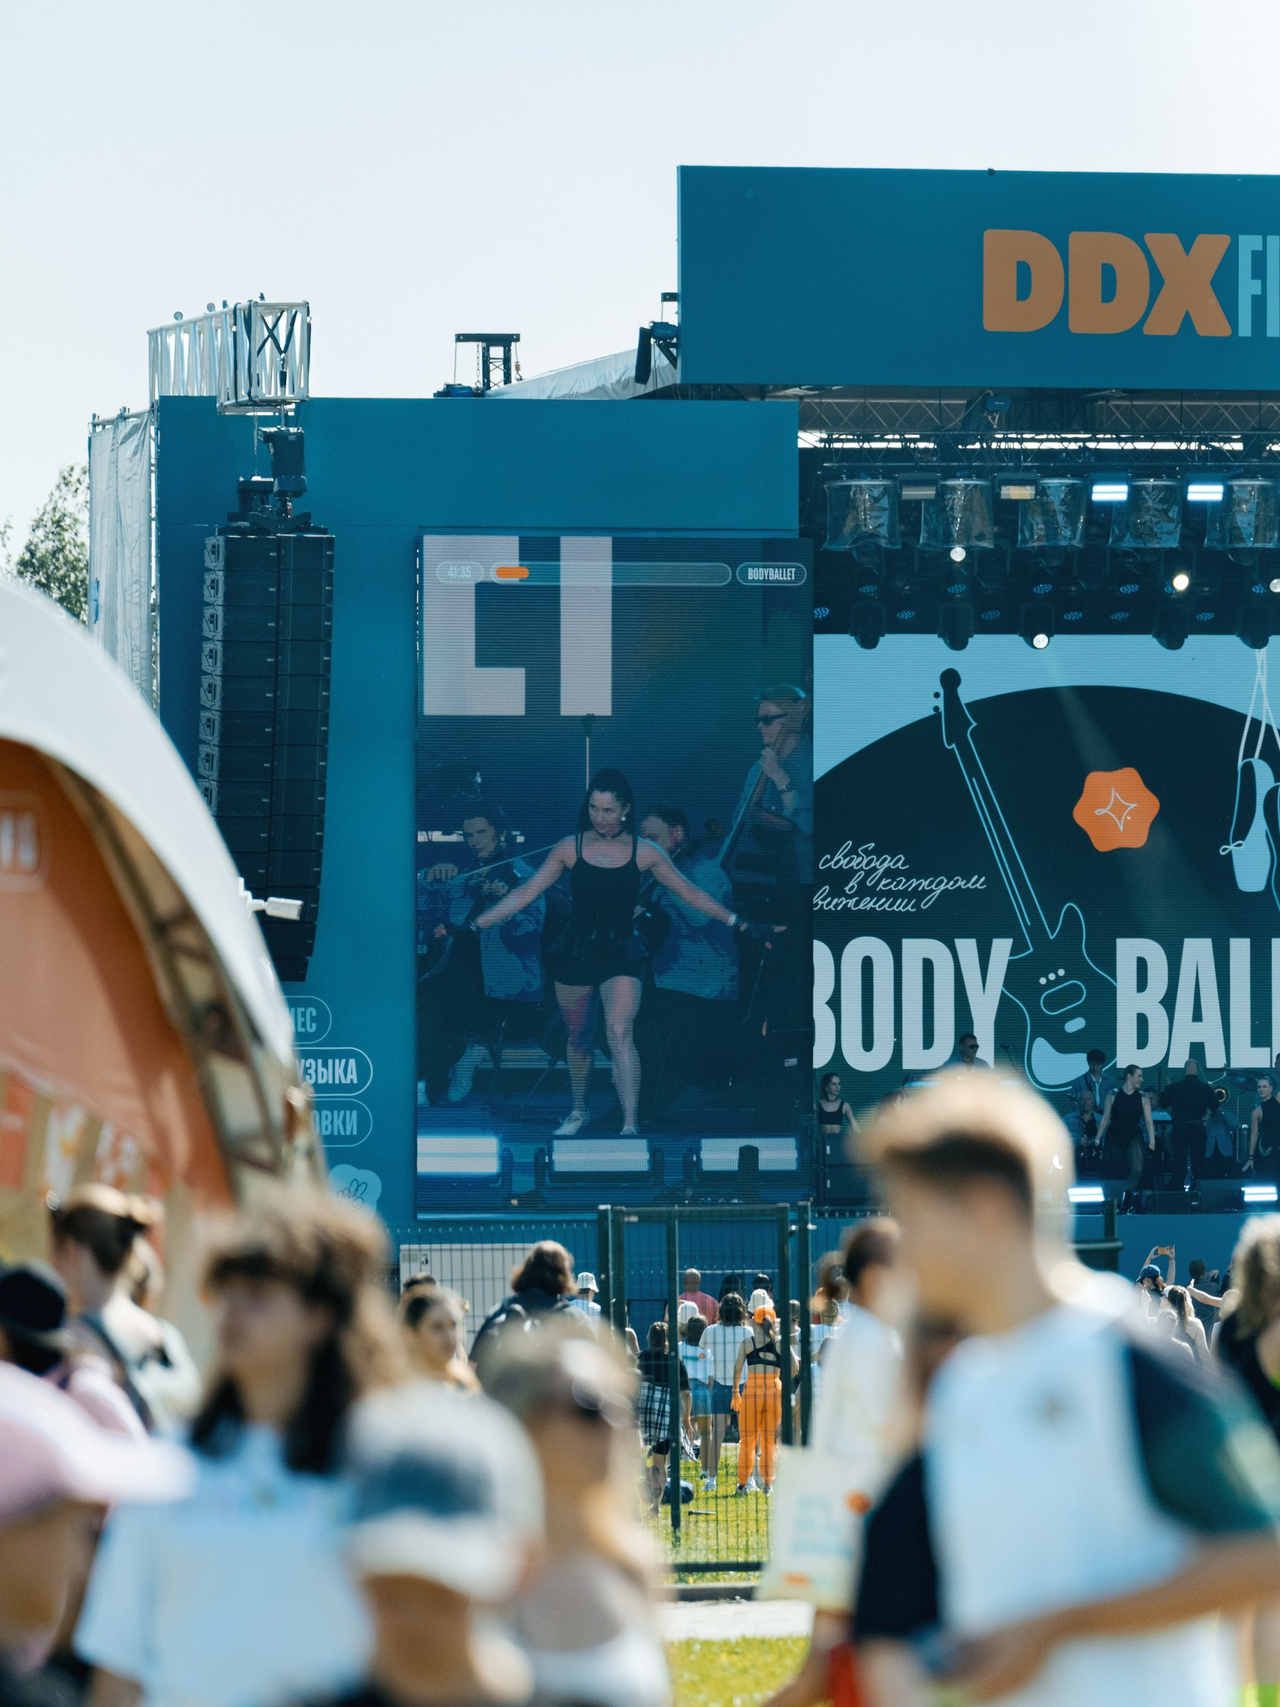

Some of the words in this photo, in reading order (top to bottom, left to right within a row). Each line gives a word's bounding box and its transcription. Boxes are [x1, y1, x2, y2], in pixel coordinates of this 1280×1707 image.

[747, 567, 796, 581] BODYBALLET
[818, 840, 910, 887] свобода
[843, 870, 865, 895] в
[876, 874, 987, 911] каждом
